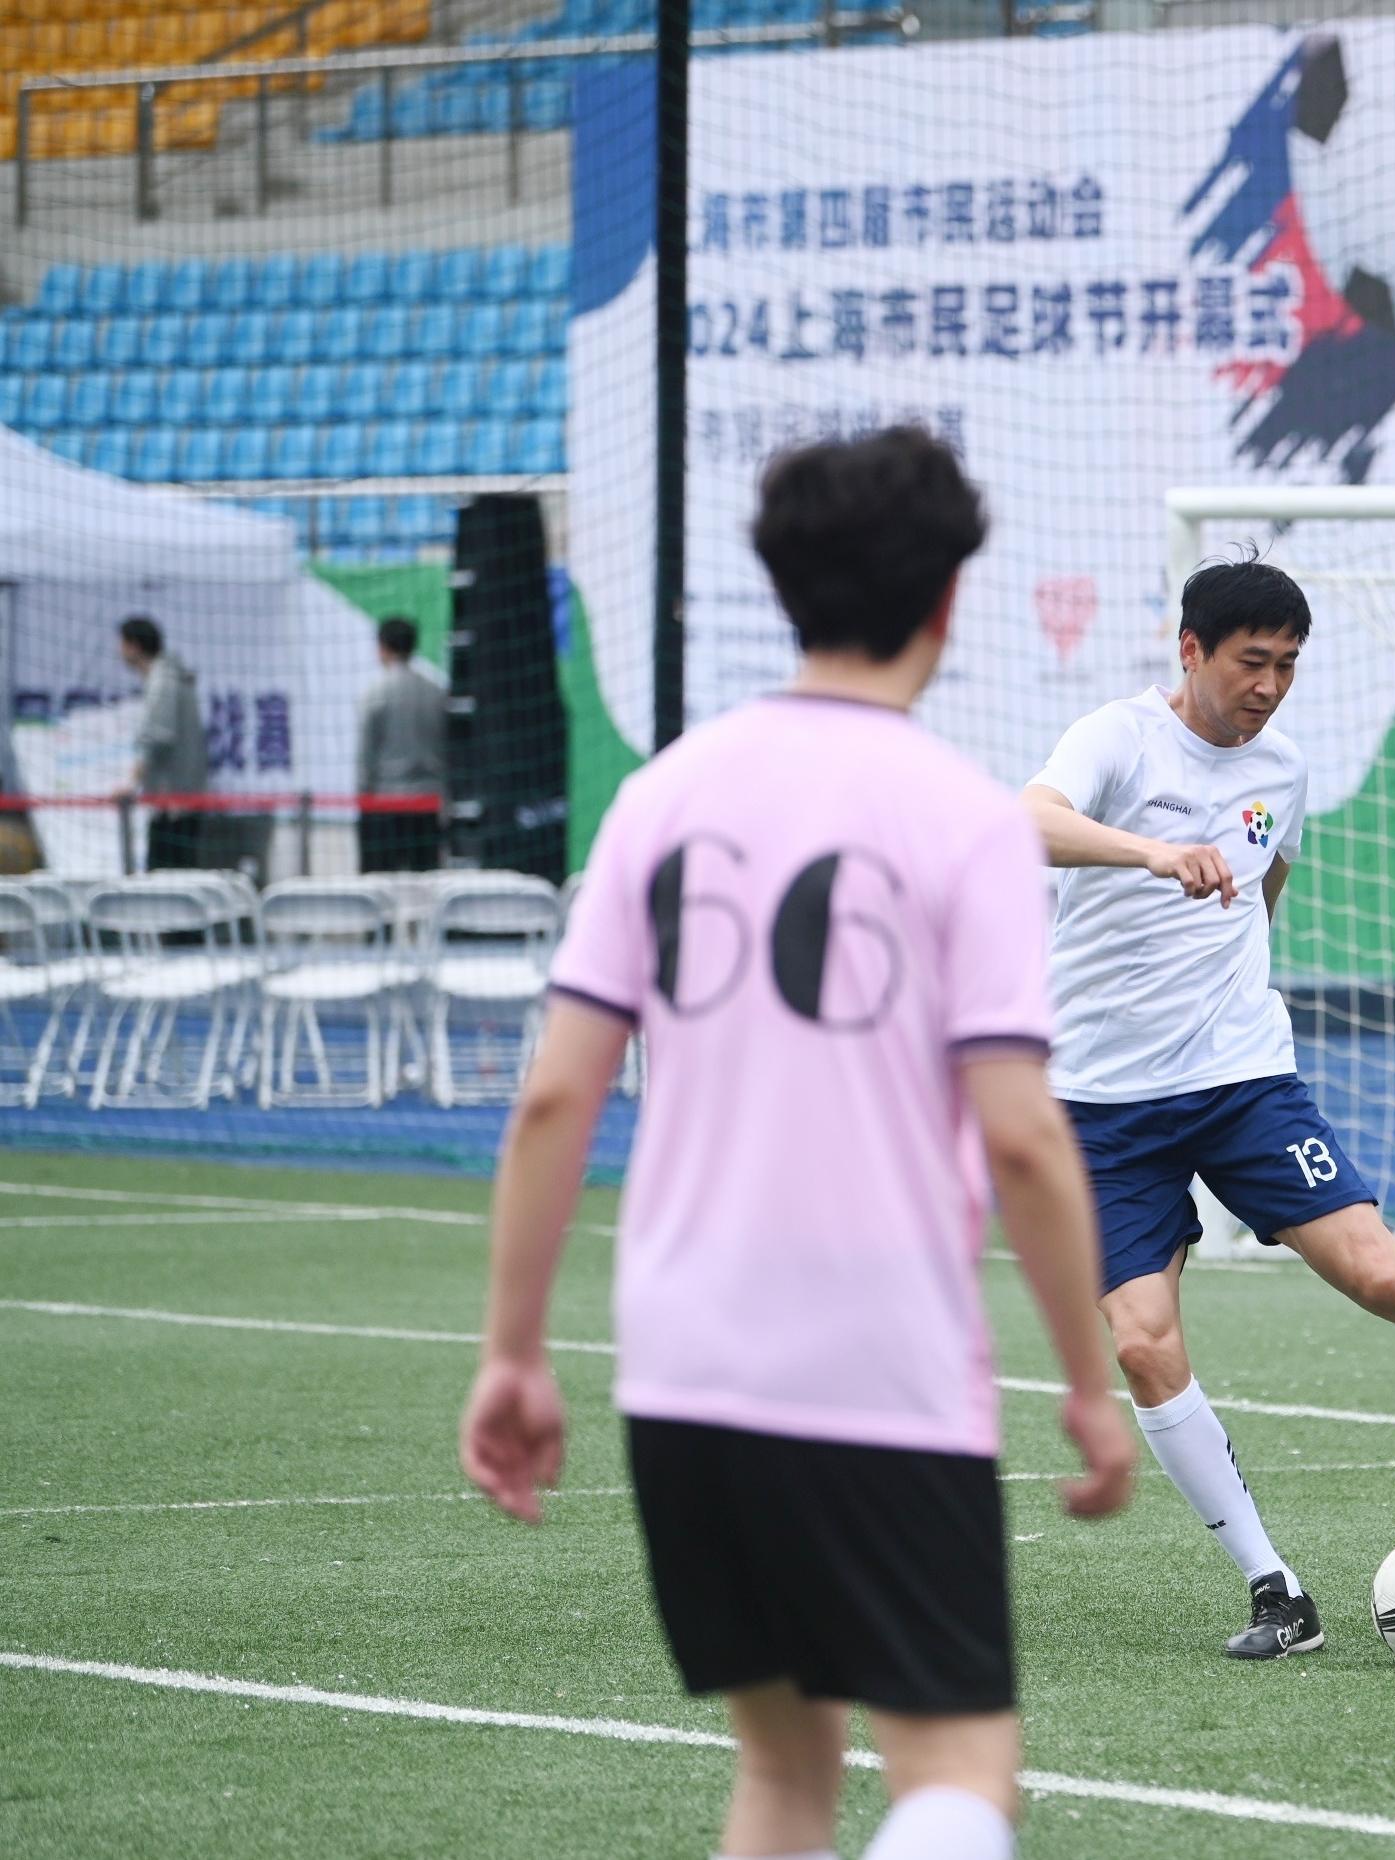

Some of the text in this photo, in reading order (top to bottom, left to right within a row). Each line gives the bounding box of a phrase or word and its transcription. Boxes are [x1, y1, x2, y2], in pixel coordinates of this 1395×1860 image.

[688, 176, 1103, 256] 海市第四届市民运动会
[1146, 799, 1192, 816] SHANGHAI
[645, 828, 907, 1037] 66
[1285, 1137, 1338, 1188] 13
